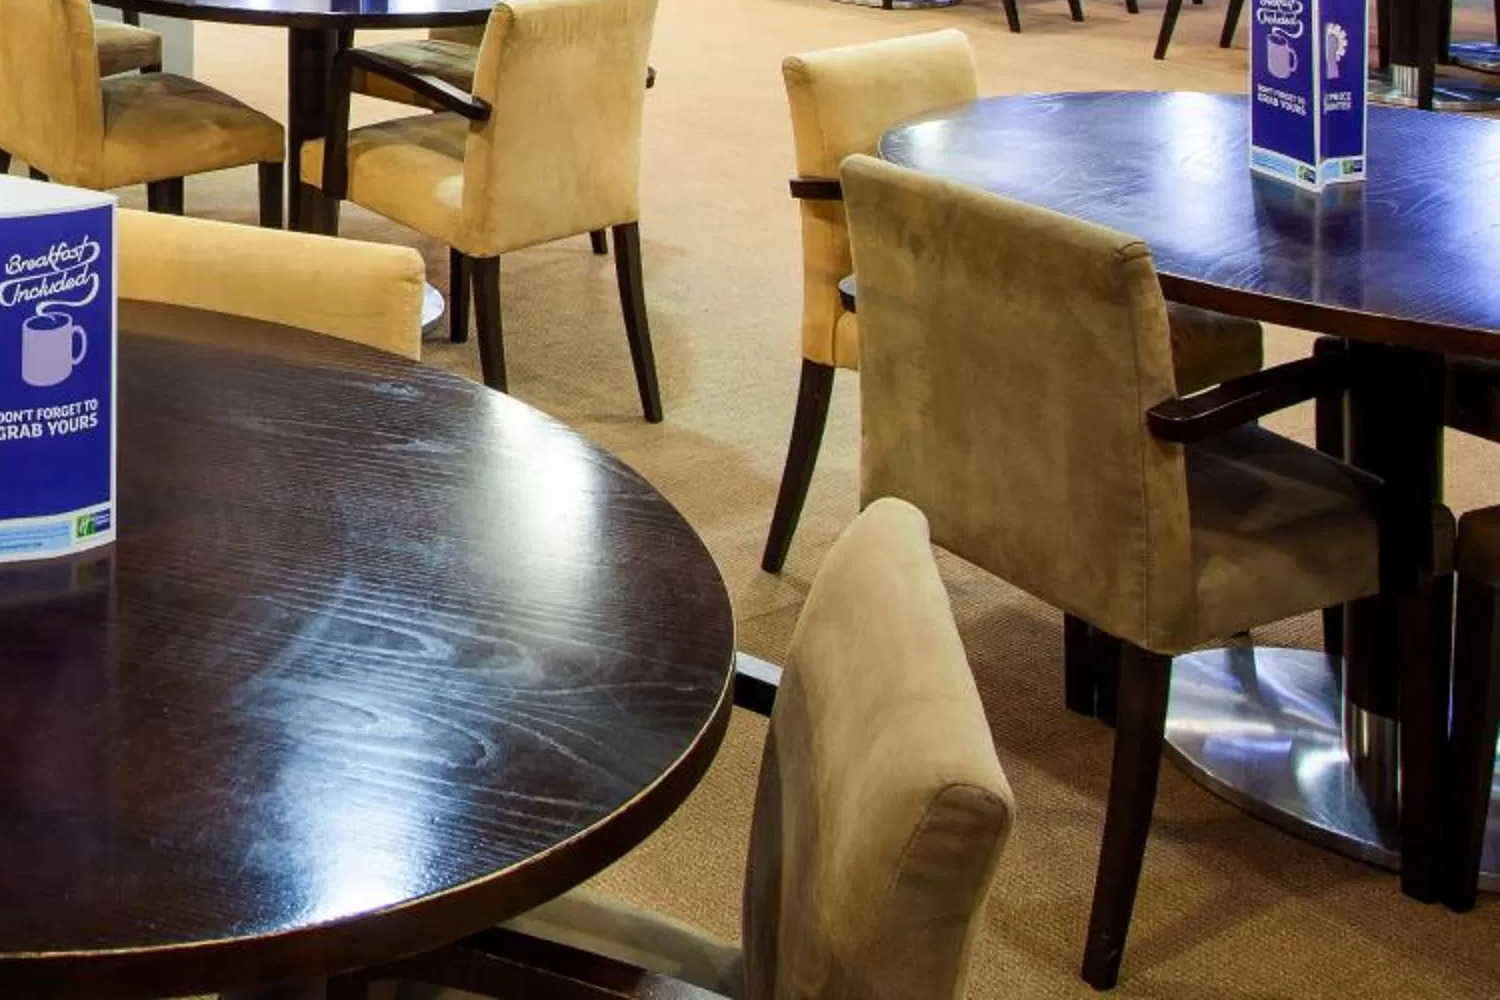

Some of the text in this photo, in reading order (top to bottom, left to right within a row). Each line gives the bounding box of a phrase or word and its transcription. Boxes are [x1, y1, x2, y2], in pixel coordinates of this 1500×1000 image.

[4, 235, 97, 275] Breakfast
[0, 264, 94, 303] Included
[37, 401, 82, 420] FORGET
[84, 398, 99, 412] TO
[47, 412, 99, 436] YOURS
